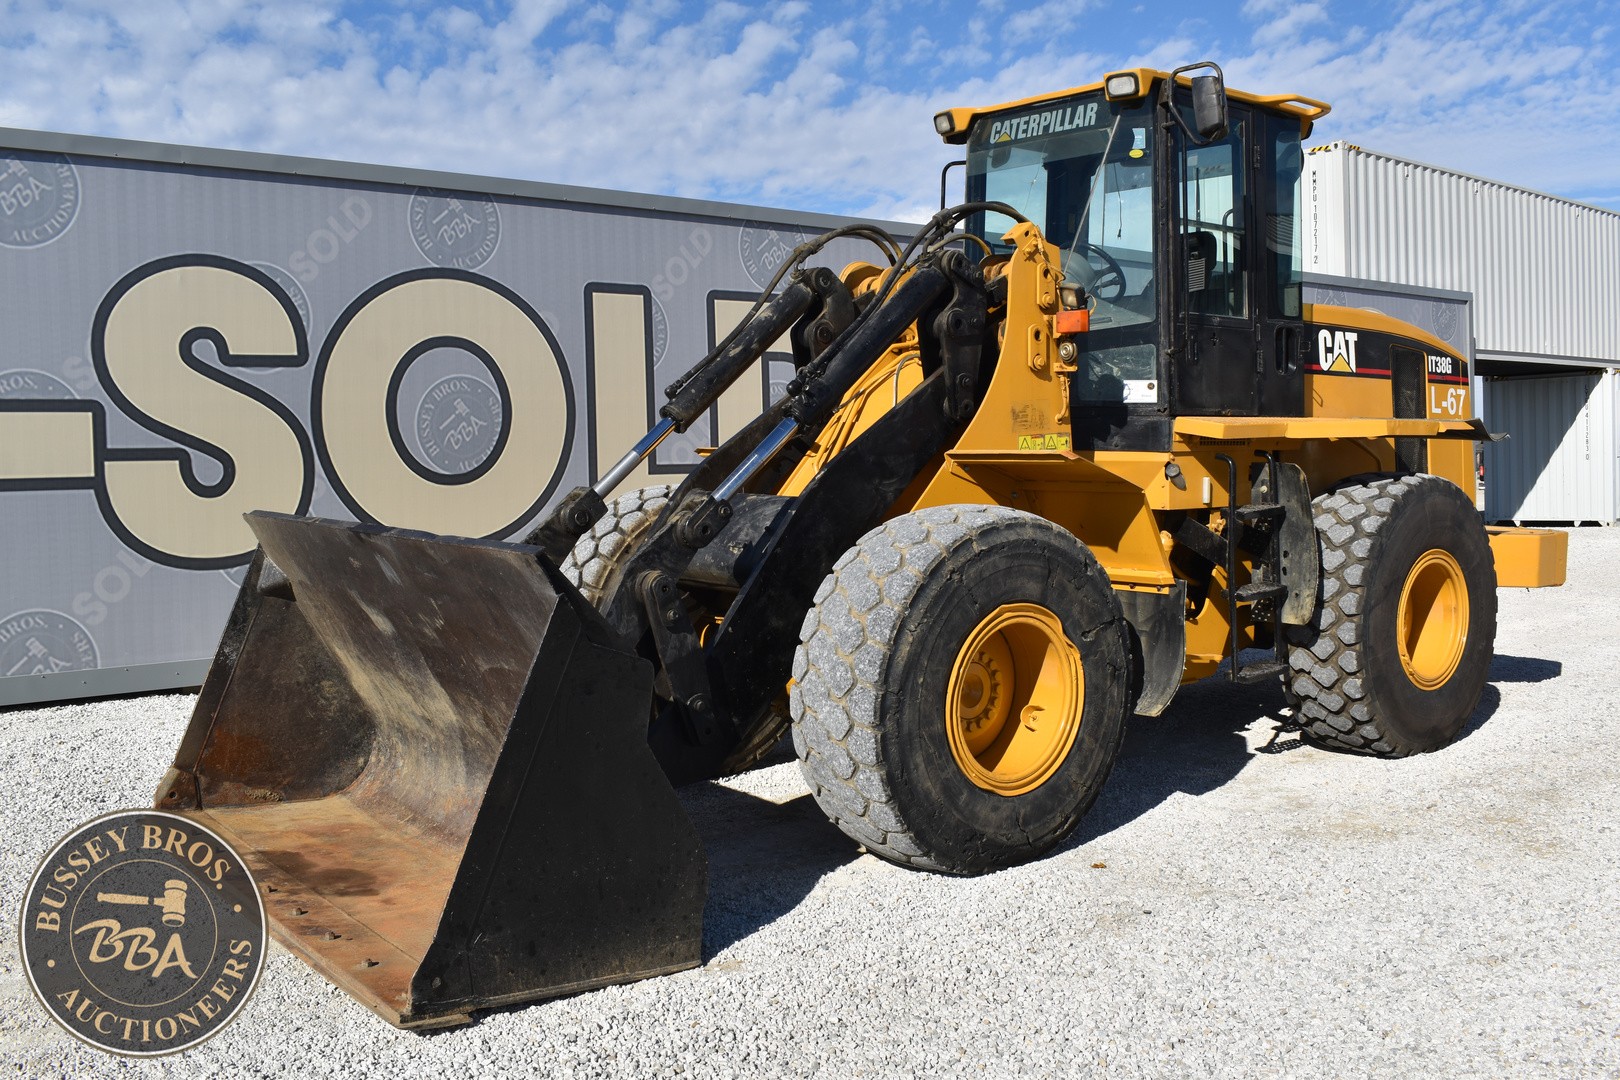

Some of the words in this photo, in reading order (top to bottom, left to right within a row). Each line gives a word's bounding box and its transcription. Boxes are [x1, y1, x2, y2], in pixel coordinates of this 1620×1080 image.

[990, 102, 1098, 145] CATERPILLAR
[288, 194, 373, 283] SOLD
[437, 212, 482, 246] BBA
[652, 225, 714, 301] SOLD
[760, 241, 794, 270] BBA
[1318, 328, 1358, 373] CAT
[1428, 355, 1452, 374] IT38G
[432, 379, 471, 402] BROS.
[1431, 385, 1466, 416] L-67
[443, 415, 487, 450] BBA
